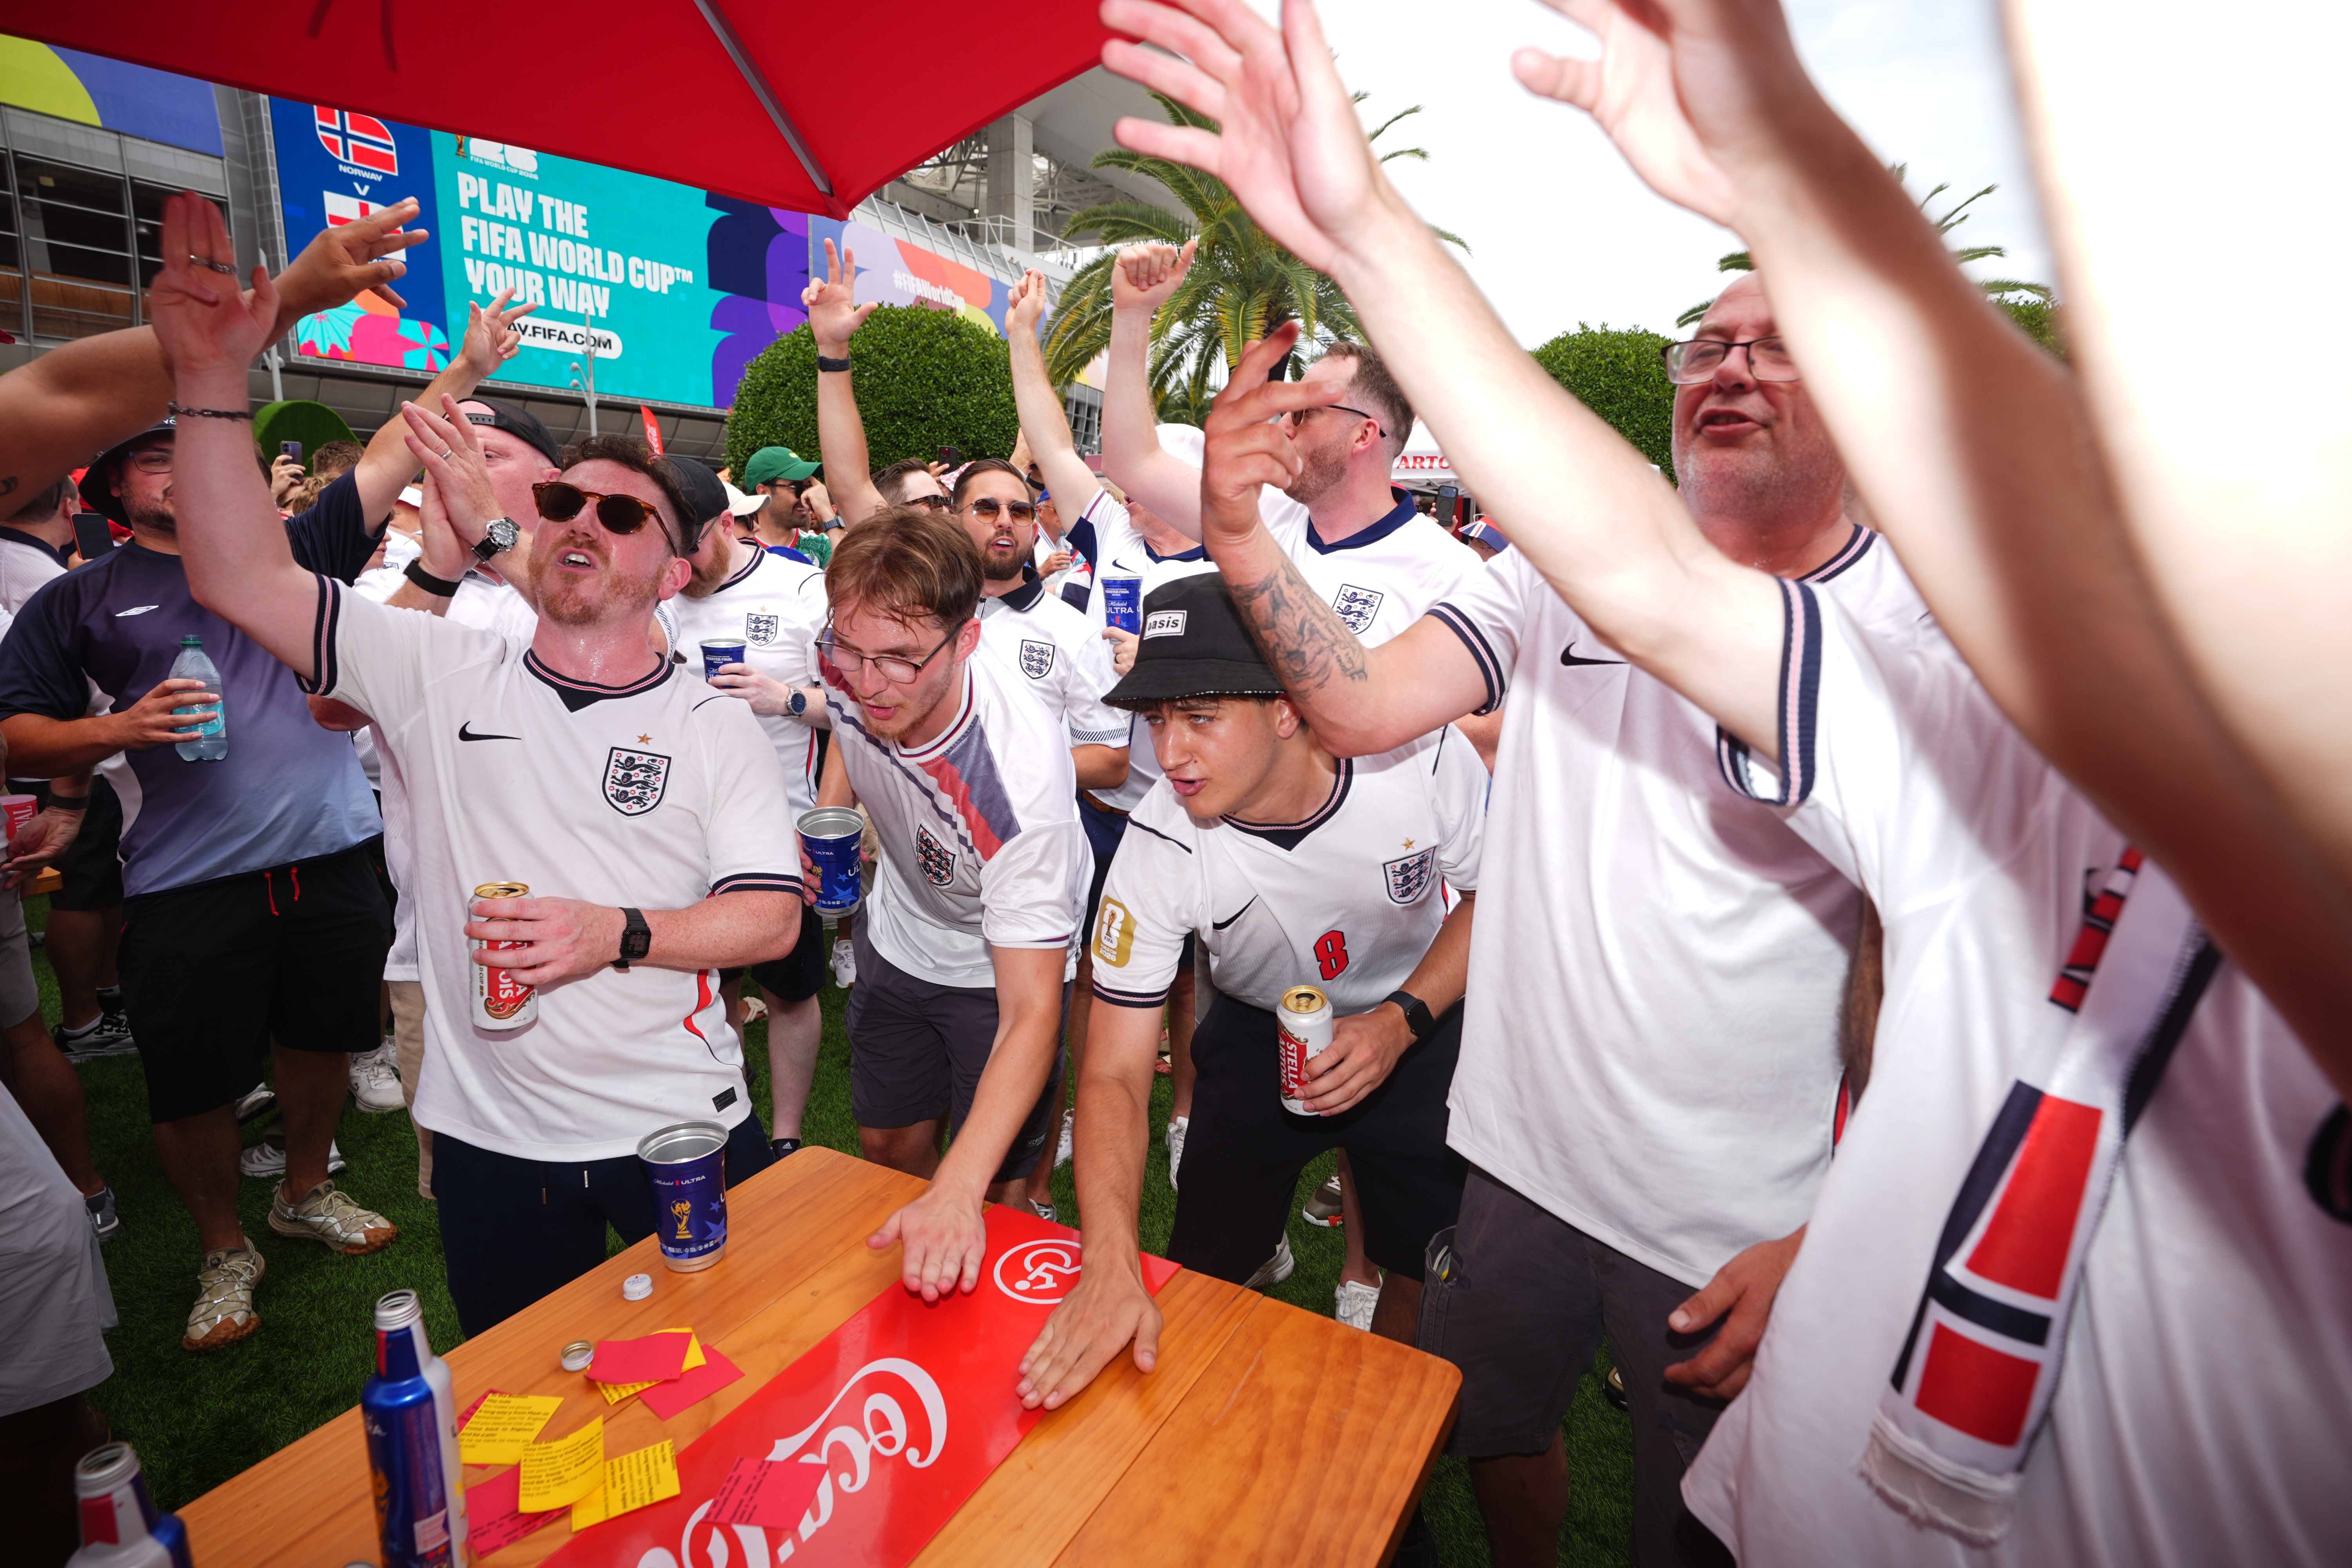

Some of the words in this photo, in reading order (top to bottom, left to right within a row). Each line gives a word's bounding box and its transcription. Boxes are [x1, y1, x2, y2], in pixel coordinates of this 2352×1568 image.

[339, 164, 382, 182] NORWAY
[470, 156, 484, 164] FIFA
[484, 158, 506, 171] WORLD
[506, 165, 518, 174] CUP
[519, 170, 539, 180] 2026
[353, 182, 370, 196] V
[457, 171, 533, 224] PLAY
[538, 194, 589, 239] THE
[461, 215, 526, 263] FIFA
[528, 231, 624, 284] WORLD
[464, 257, 545, 307] YOUR
[548, 275, 610, 318] WAY
[893, 270, 966, 314] #FIFAWorldCup
[507, 322, 612, 350] AY.FIFA.COM
[1396, 456, 1452, 469] ARTO
[1148, 617, 1179, 631] oasis
[13, 806, 33, 832] NAL
[1100, 943, 1110, 951] WORLD
[1100, 947, 1116, 962] 2026
[1314, 930, 1349, 980] 8
[1279, 1034, 1287, 1087] ARTOIS
[1287, 1042, 1298, 1089] STELLA
[681, 1175, 706, 1185] ULTRA
